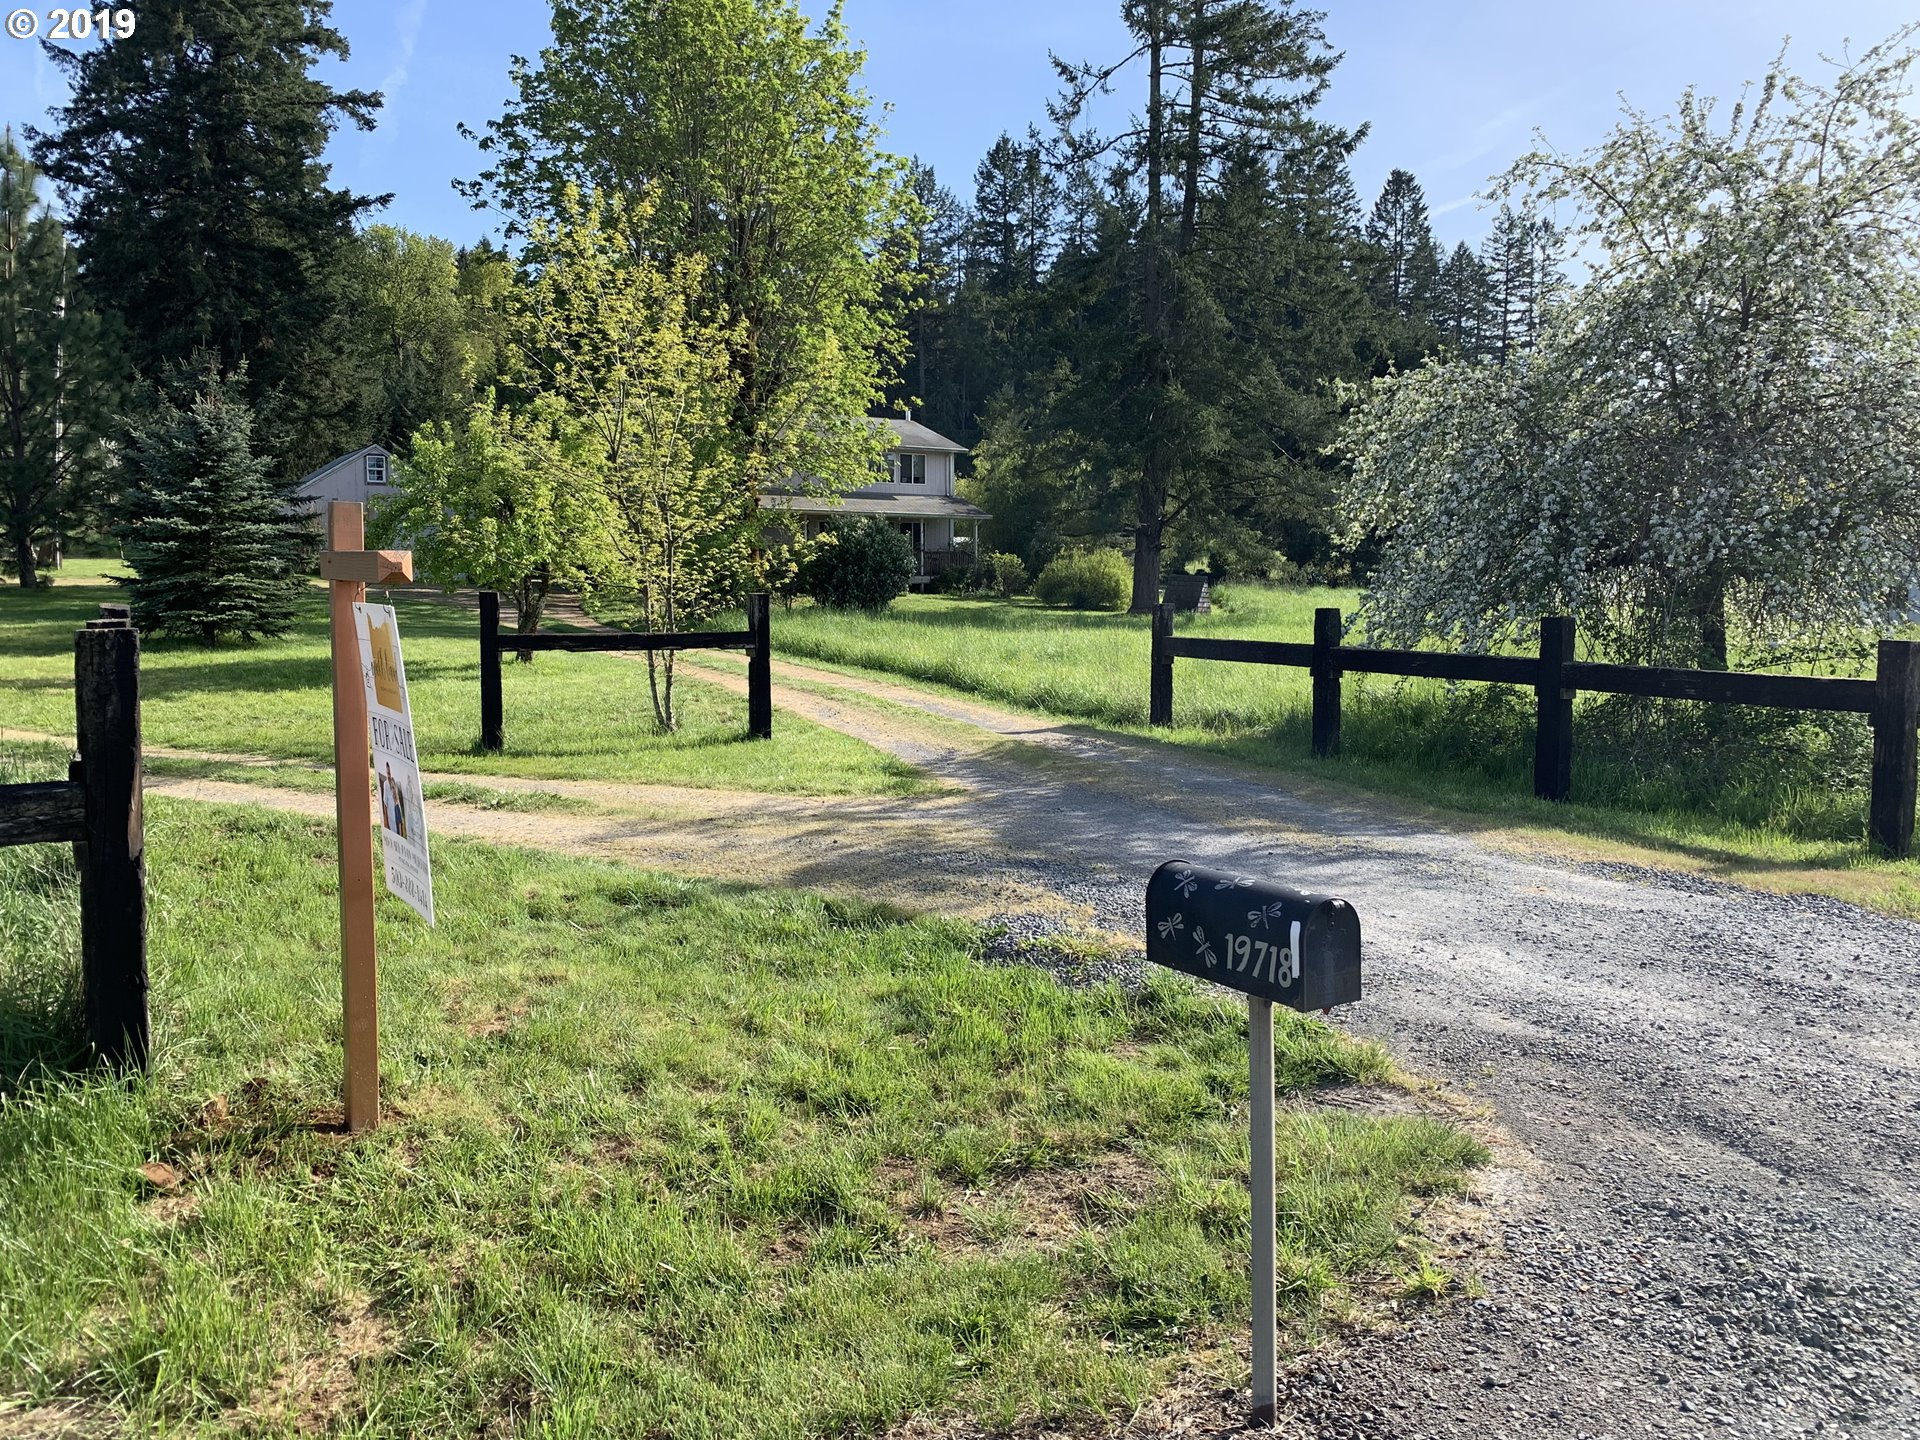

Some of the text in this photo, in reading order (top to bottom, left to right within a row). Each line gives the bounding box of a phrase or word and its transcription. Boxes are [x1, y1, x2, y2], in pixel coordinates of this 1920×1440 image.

[372, 716, 415, 763] FOR SALE
[1224, 933, 1293, 988] 19718
